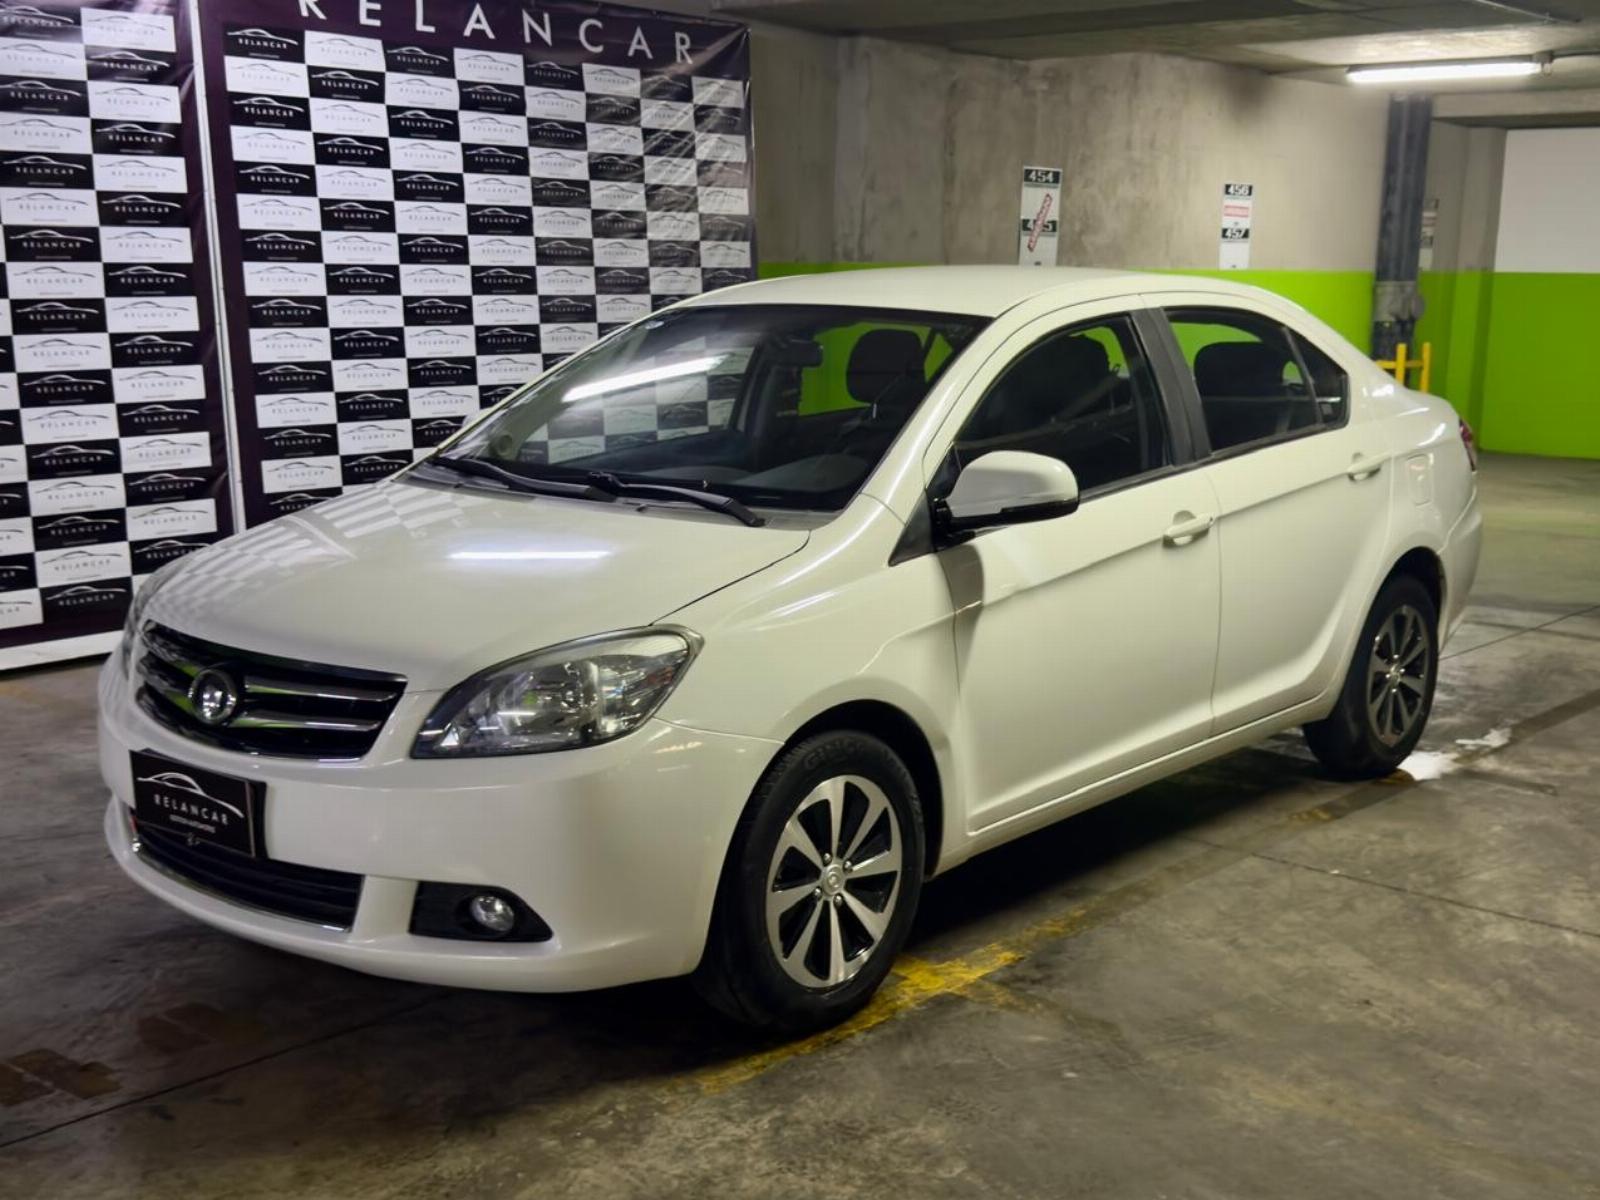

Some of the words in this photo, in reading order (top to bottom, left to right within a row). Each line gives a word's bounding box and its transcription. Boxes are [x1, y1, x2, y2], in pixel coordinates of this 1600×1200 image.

[238, 38, 287, 49] RELANCAR
[103, 61, 158, 71] RELANCAR
[10, 91, 68, 101] RELANCAR
[245, 107, 294, 117] RELANCAR
[108, 135, 163, 143] RELANCAR
[16, 167, 74, 175] RELANCAR
[251, 175, 300, 184] RELANCAR
[1029, 170, 1054, 183] 454
[1228, 185, 1249, 196] 456
[1027, 219, 1053, 232] 45
[1225, 229, 1247, 239] 457
[127, 346, 181, 354] RELANCAR
[269, 374, 316, 382] RELANCAR
[36, 384, 94, 393] RELANCAR
[134, 414, 188, 423] RELANCAR
[274, 437, 322, 446] RELANCAR
[45, 456, 102, 465] RELANCAR
[142, 482, 195, 492] RELANCAR
[51, 524, 107, 535] RELANCAR
[59, 593, 114, 606] RELANCAR
[154, 794, 228, 825] RELANCAR
